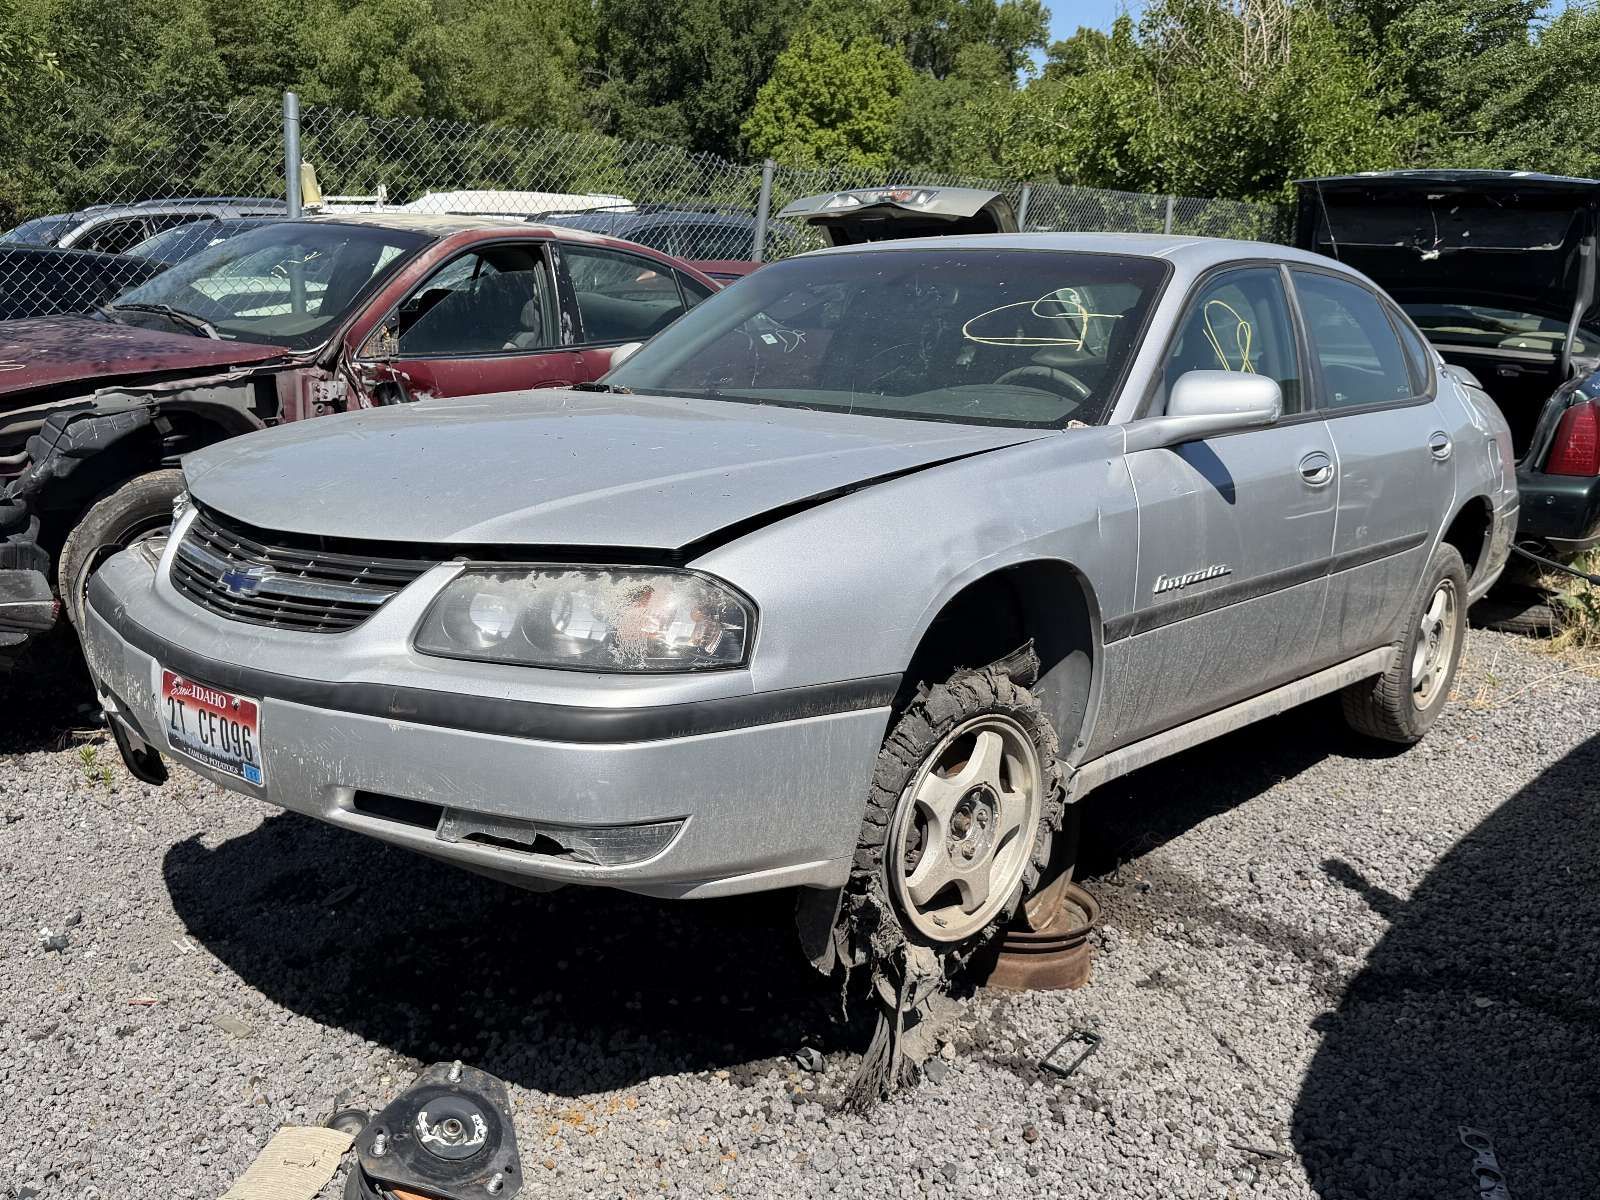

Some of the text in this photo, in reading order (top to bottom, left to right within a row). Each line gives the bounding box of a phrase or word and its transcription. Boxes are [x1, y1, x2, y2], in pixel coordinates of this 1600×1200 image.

[1153, 564, 1233, 593] Impala
[191, 684, 227, 709] IDAHO
[167, 695, 253, 761] 2T CF096
